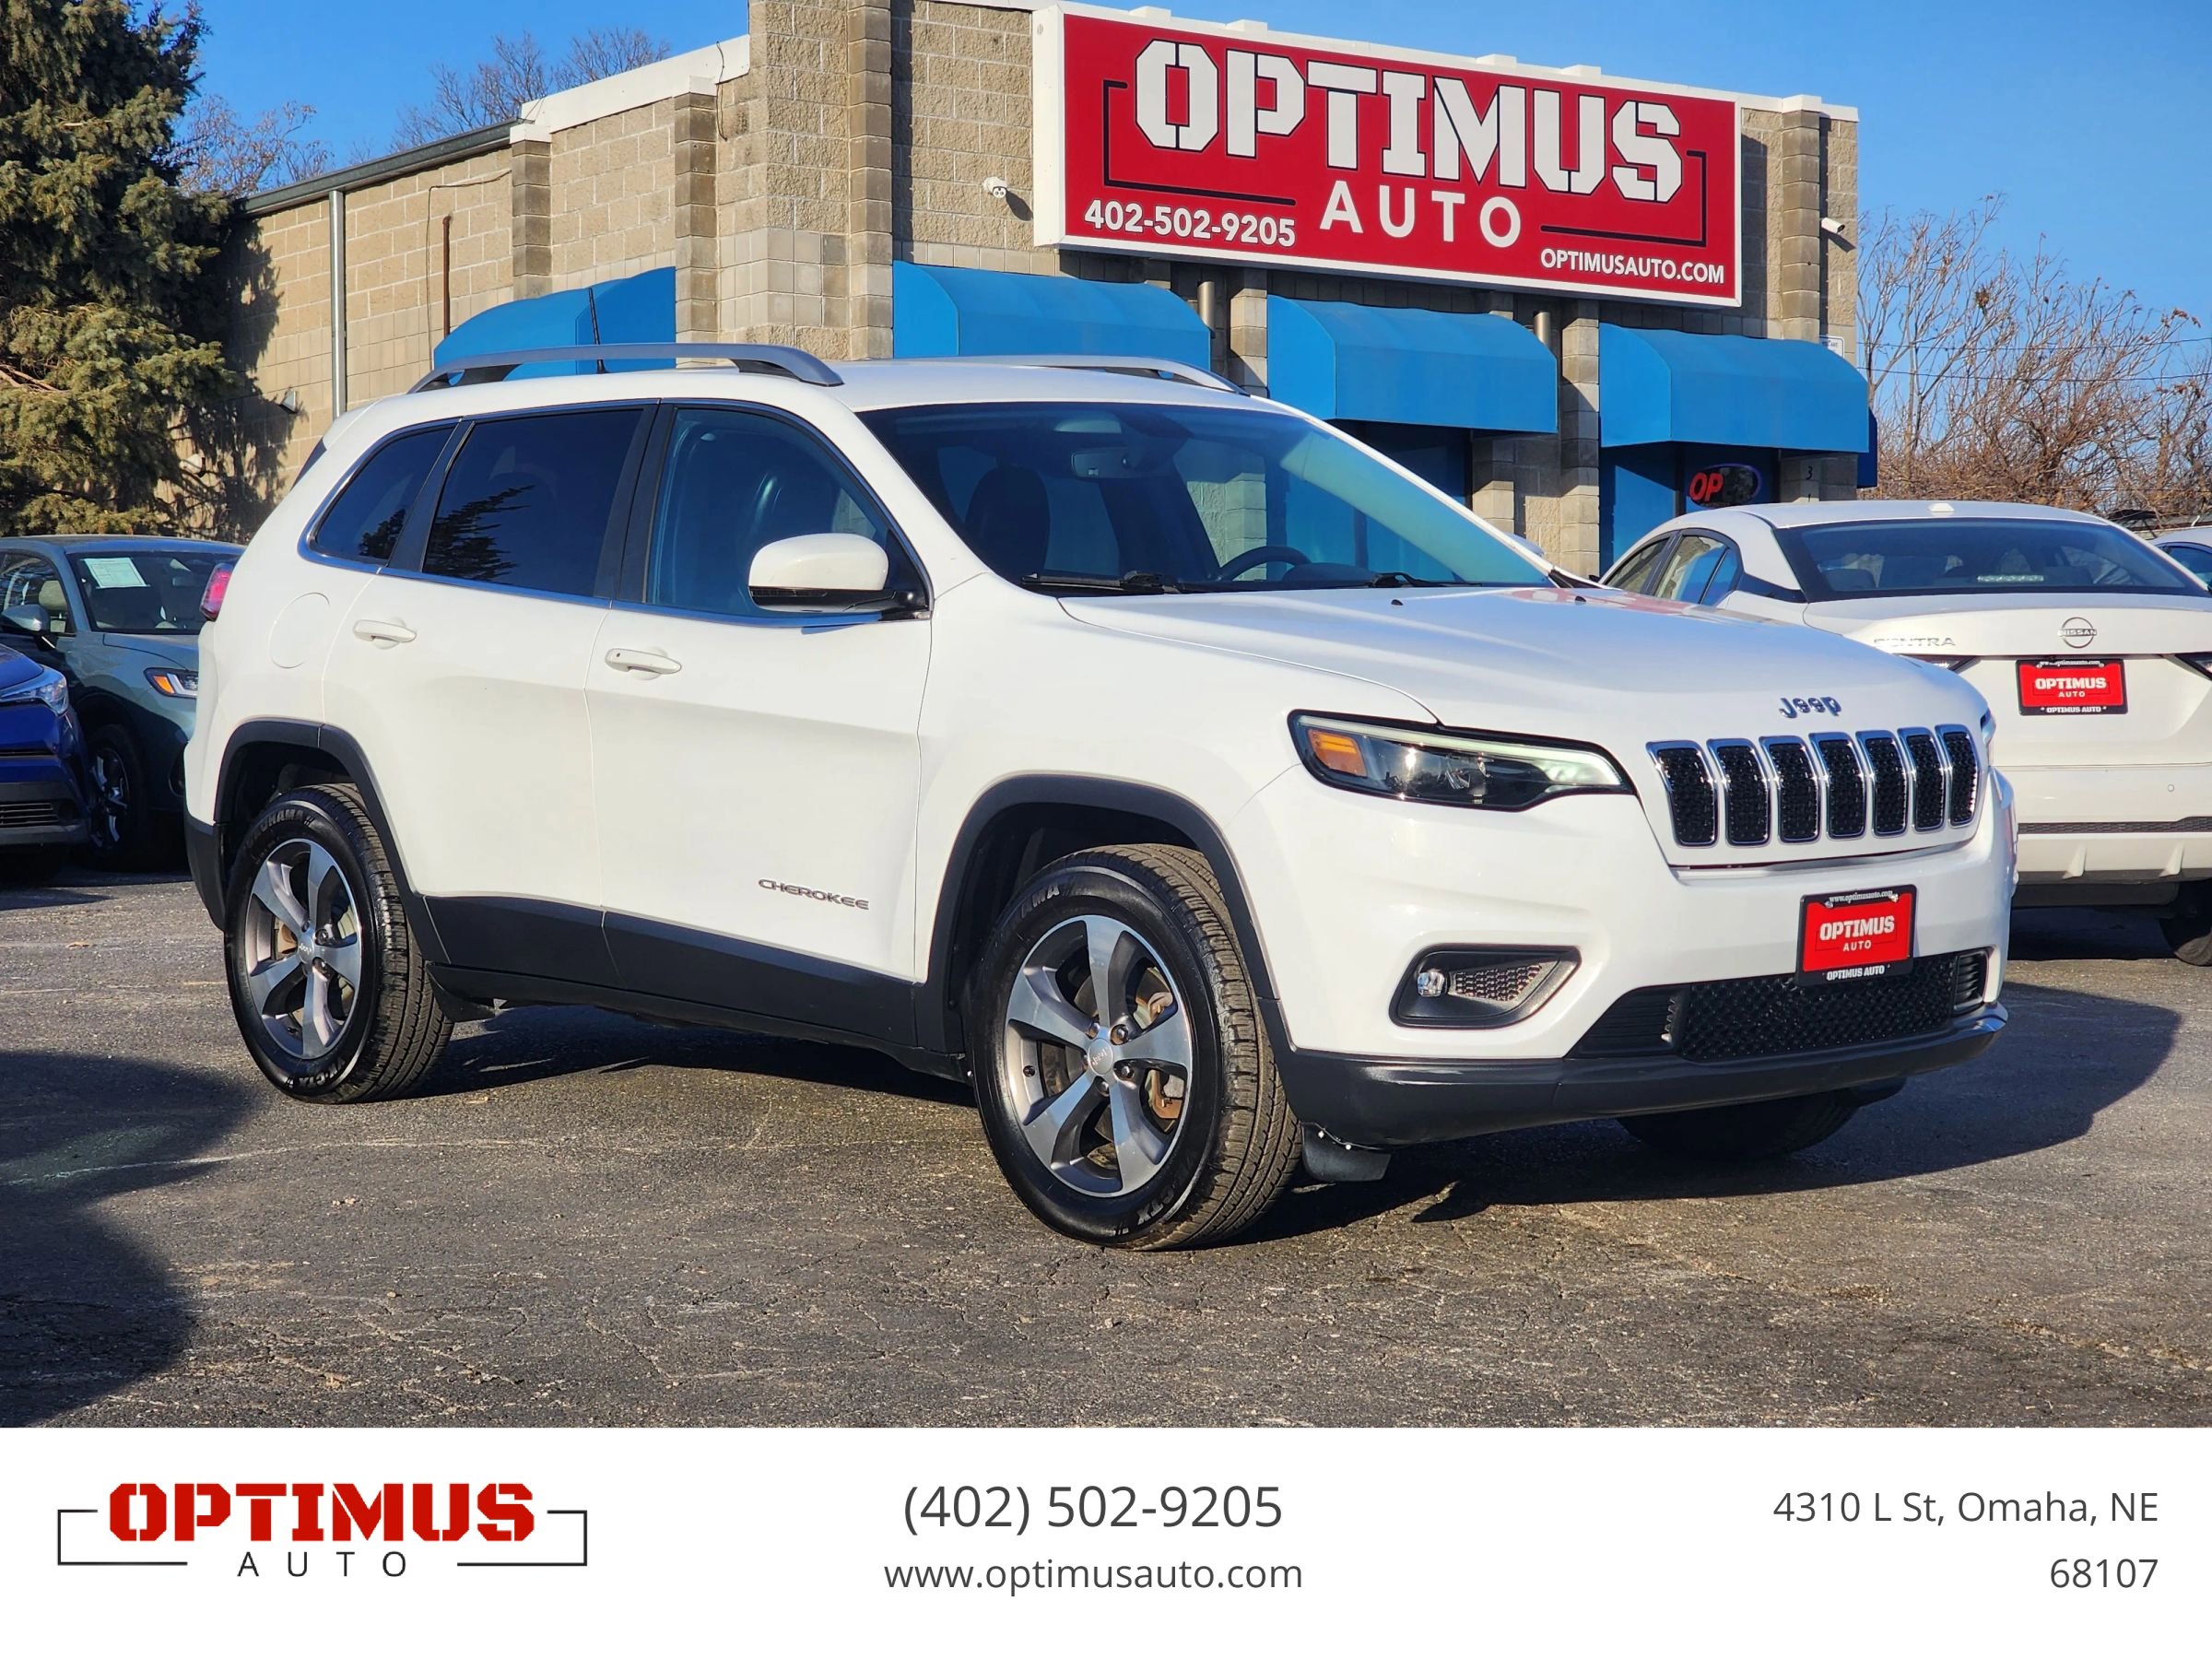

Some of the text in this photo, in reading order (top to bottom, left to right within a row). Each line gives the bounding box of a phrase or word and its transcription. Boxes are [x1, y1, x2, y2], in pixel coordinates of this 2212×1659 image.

[1135, 39, 1682, 202] OPTIMUS
[1085, 199, 1296, 247] 402-502-9205
[1320, 181, 1522, 248] AUTO
[1540, 248, 1724, 284] OPTIMUSAUTO.COM
[2035, 677, 2107, 689] OPTIMUS
[1779, 697, 1841, 719] Jeep
[759, 879, 869, 910] CHEROKEE
[1819, 915, 1895, 940] OPTIMUS
[1843, 940, 1872, 951] AUTO
[1827, 965, 1885, 981] OPTIMUS AUTO
